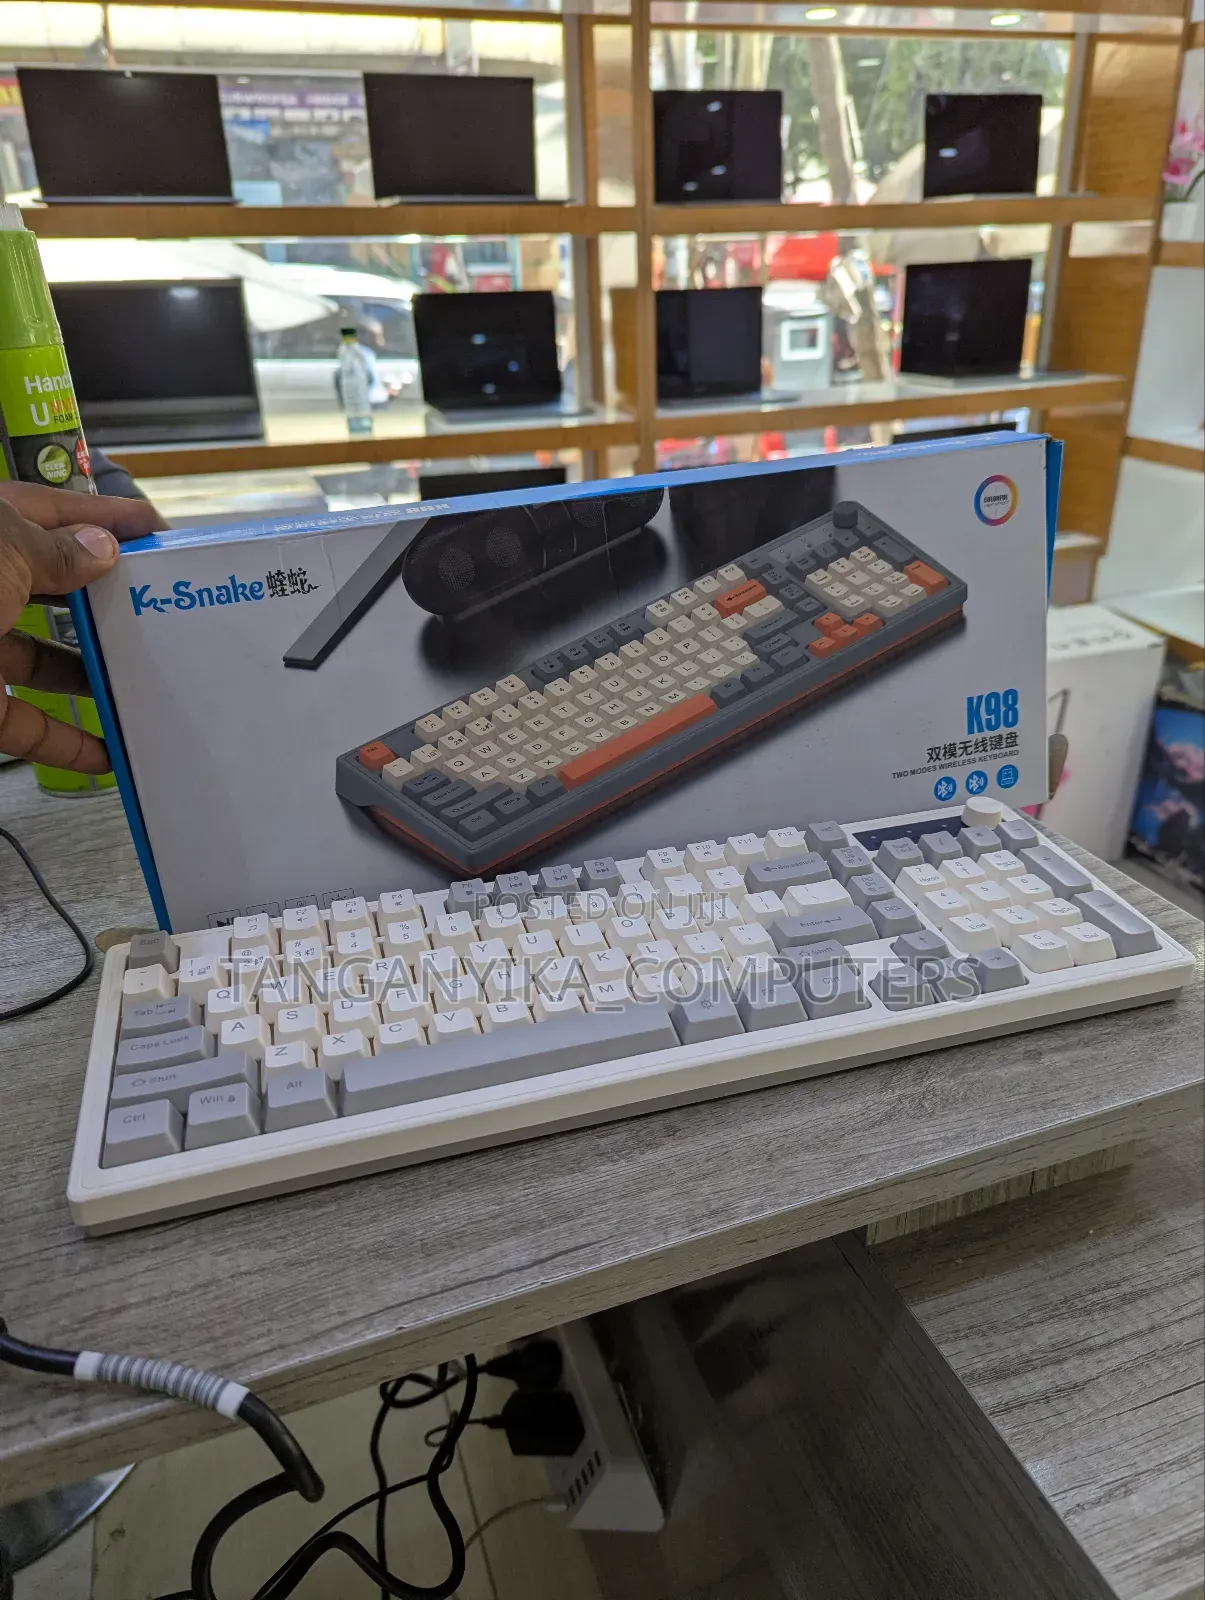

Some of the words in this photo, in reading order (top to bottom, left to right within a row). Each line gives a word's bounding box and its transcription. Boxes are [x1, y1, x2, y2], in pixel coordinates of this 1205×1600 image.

[966, 688, 1019, 735] K98
[926, 731, 1019, 763] 双模无线键盘
[892, 770, 909, 780] TWO
[910, 765, 937, 776] MODES
[938, 757, 977, 771] WIRELESS
[978, 749, 1020, 763] KEYBOARD
[799, 918, 824, 928] Enter
[526, 935, 538, 945] U
[476, 943, 488, 953] Y
[811, 945, 833, 955] Shift
[427, 952, 439, 962] T
[596, 952, 610, 962] K
[376, 961, 389, 971] R
[323, 971, 335, 981] E
[497, 970, 512, 980] H
[269, 979, 288, 990] W
[448, 979, 463, 989] G
[598, 984, 614, 993] M
[216, 989, 231, 1000] Q
[549, 993, 563, 1002] N
[341, 1001, 354, 1010] D
[495, 1004, 509, 1013] B
[133, 1008, 153, 1016] Tab
[286, 1010, 299, 1020] S
[442, 1012, 456, 1022] V
[230, 1021, 245, 1032] A
[388, 1023, 403, 1033] C
[130, 1041, 160, 1052] Caps
[162, 1033, 190, 1045] Lock
[332, 1034, 346, 1045] X
[274, 1046, 288, 1057] Z
[149, 1073, 177, 1085] Shift
[286, 1079, 303, 1090] Alt
[200, 1094, 224, 1105] Win
[122, 1112, 146, 1124] Ctrl
